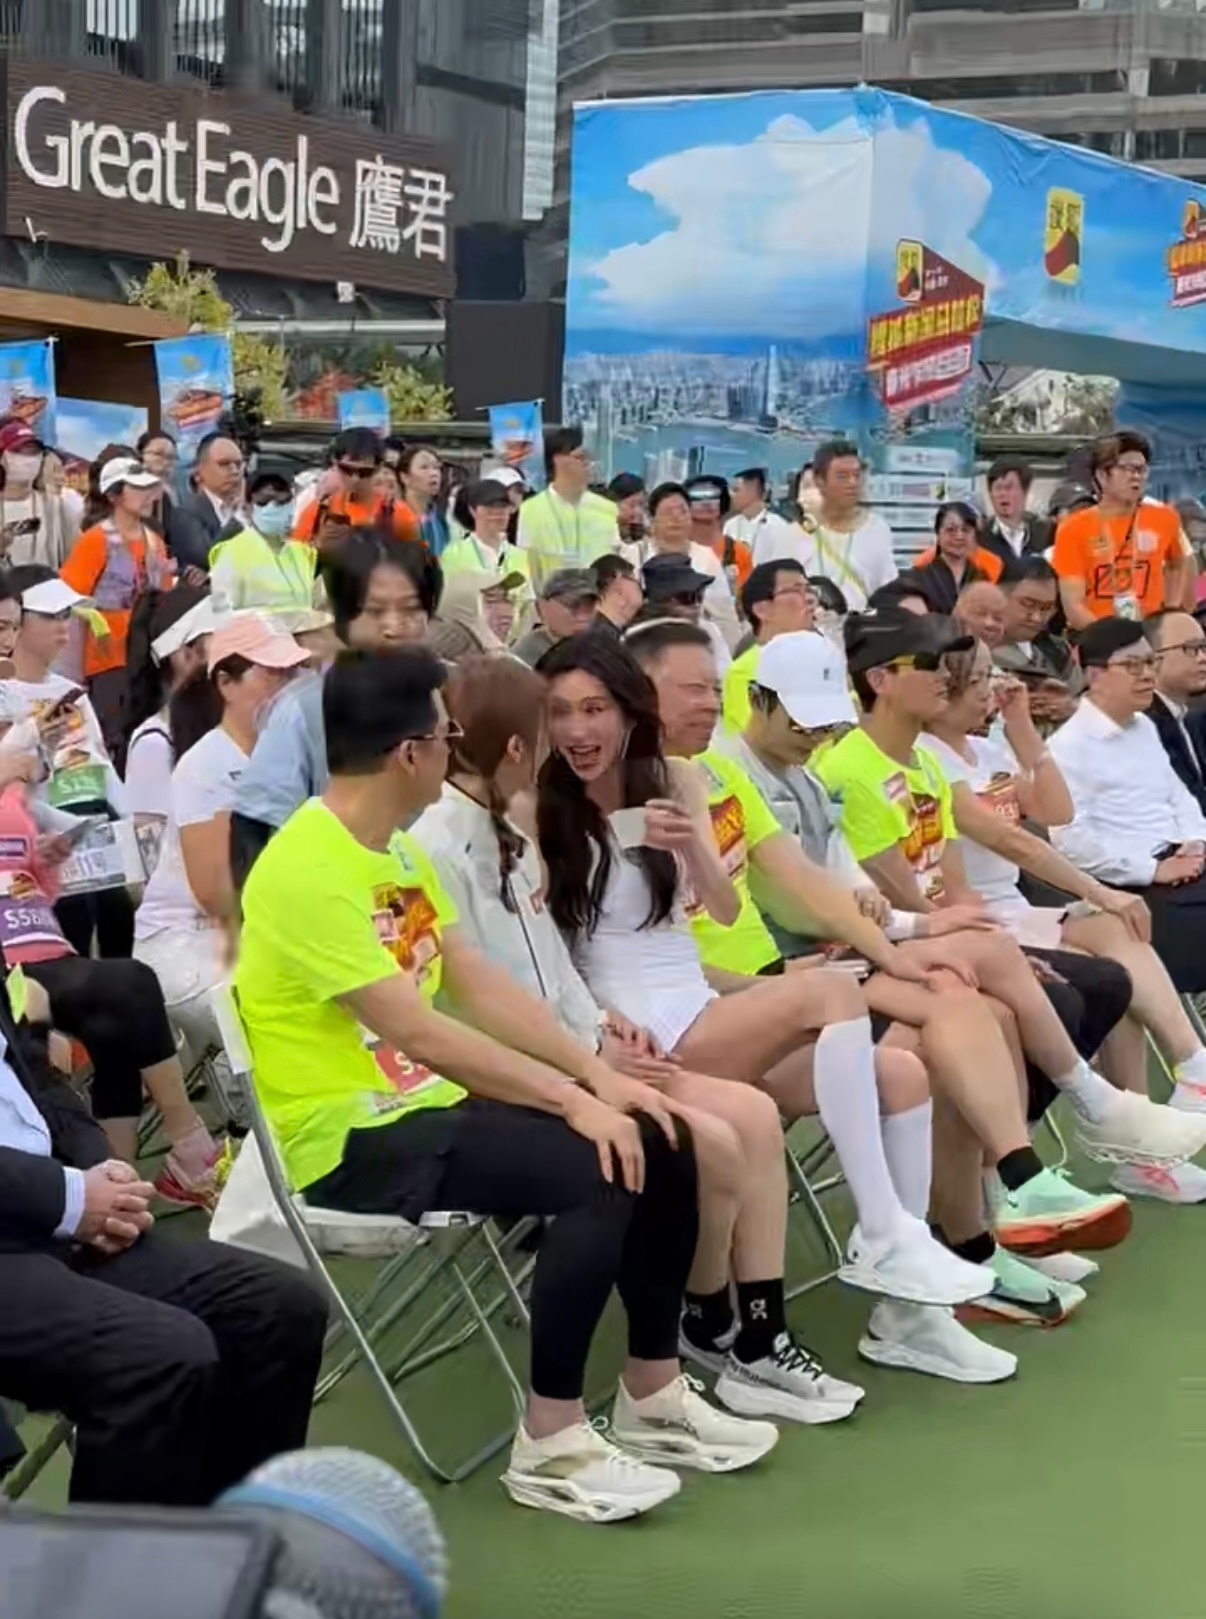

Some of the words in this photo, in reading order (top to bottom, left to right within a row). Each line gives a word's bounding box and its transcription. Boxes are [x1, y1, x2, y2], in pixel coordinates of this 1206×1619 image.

[14, 86, 187, 210] Great
[195, 119, 340, 253] Eagle
[348, 154, 454, 263] 鷹君
